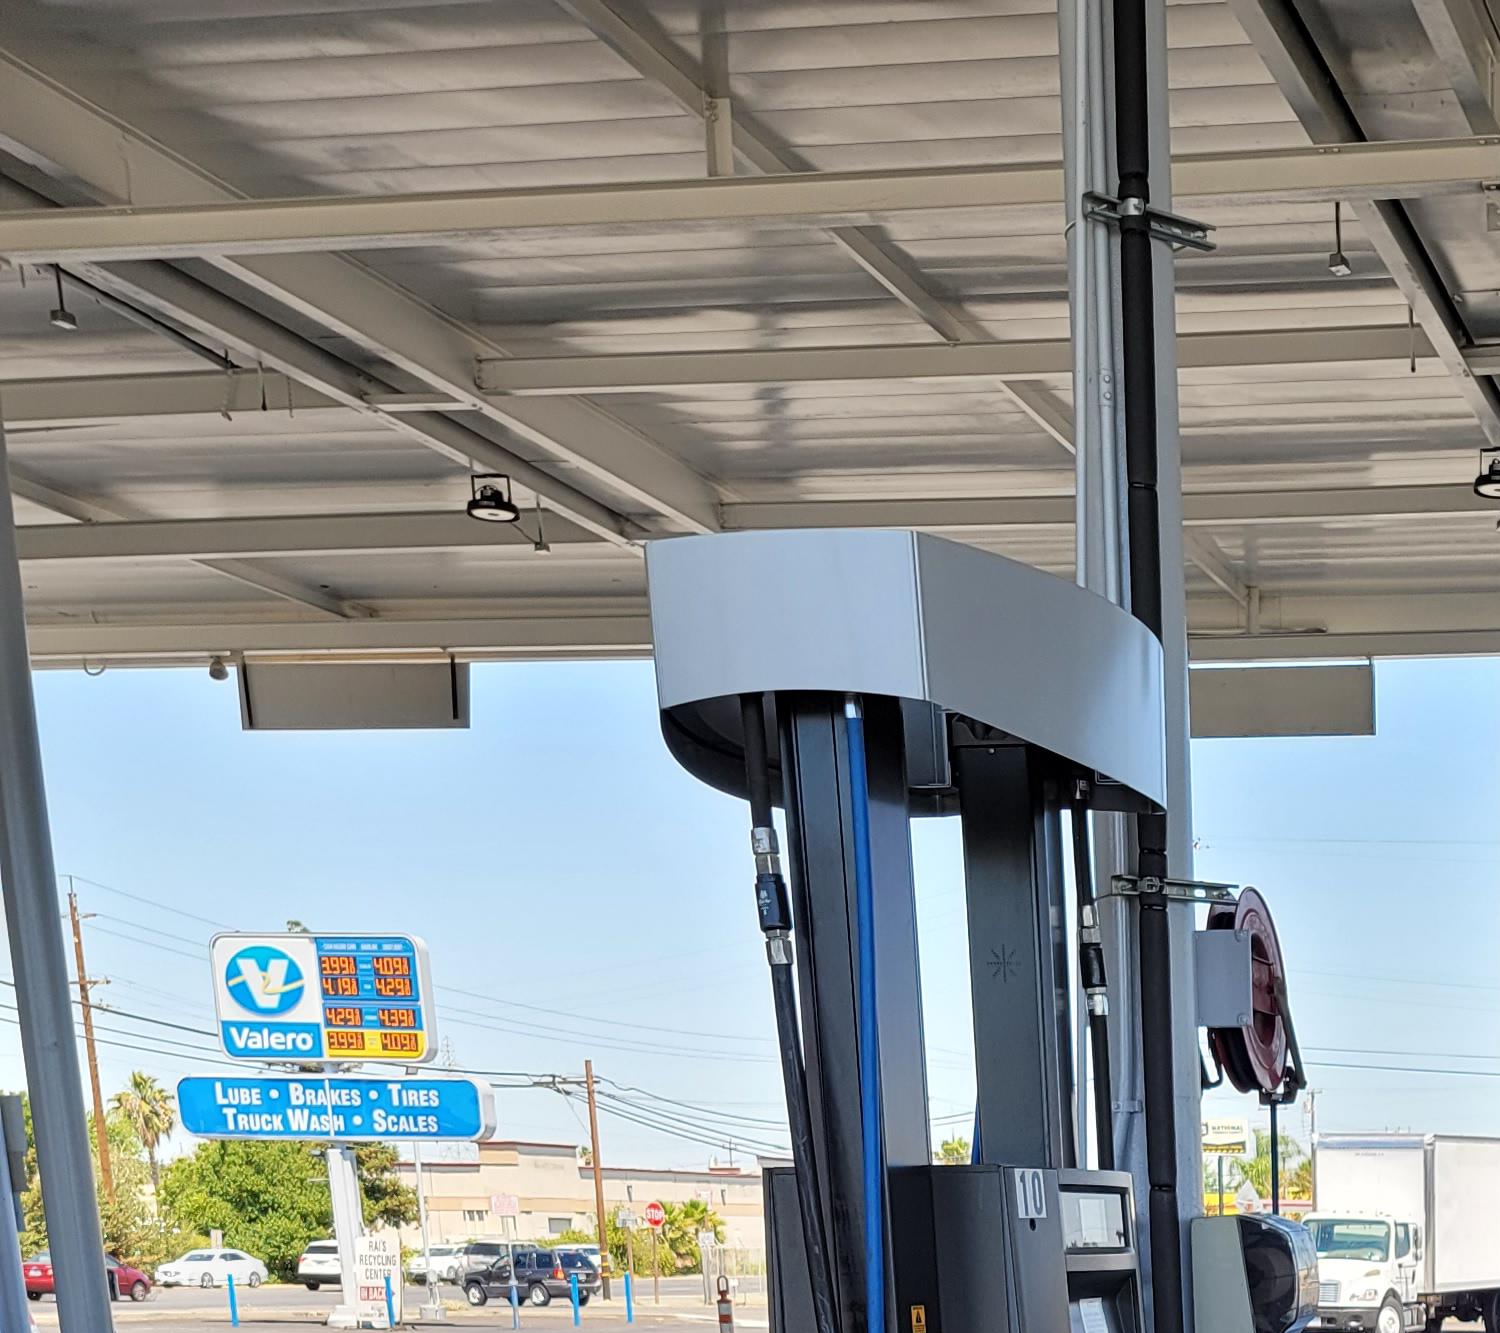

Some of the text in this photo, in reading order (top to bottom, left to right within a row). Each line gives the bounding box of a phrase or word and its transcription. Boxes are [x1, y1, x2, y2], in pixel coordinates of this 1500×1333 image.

[229, 1026, 314, 1051] Valero
[215, 1081, 440, 1107] LUBE BRAKES TIRES
[222, 1107, 438, 1133] TRUCK WASH SCALES
[1020, 1170, 1043, 1216] 10
[646, 1207, 664, 1221] STOP
[360, 1254, 397, 1266] RECYCLING
